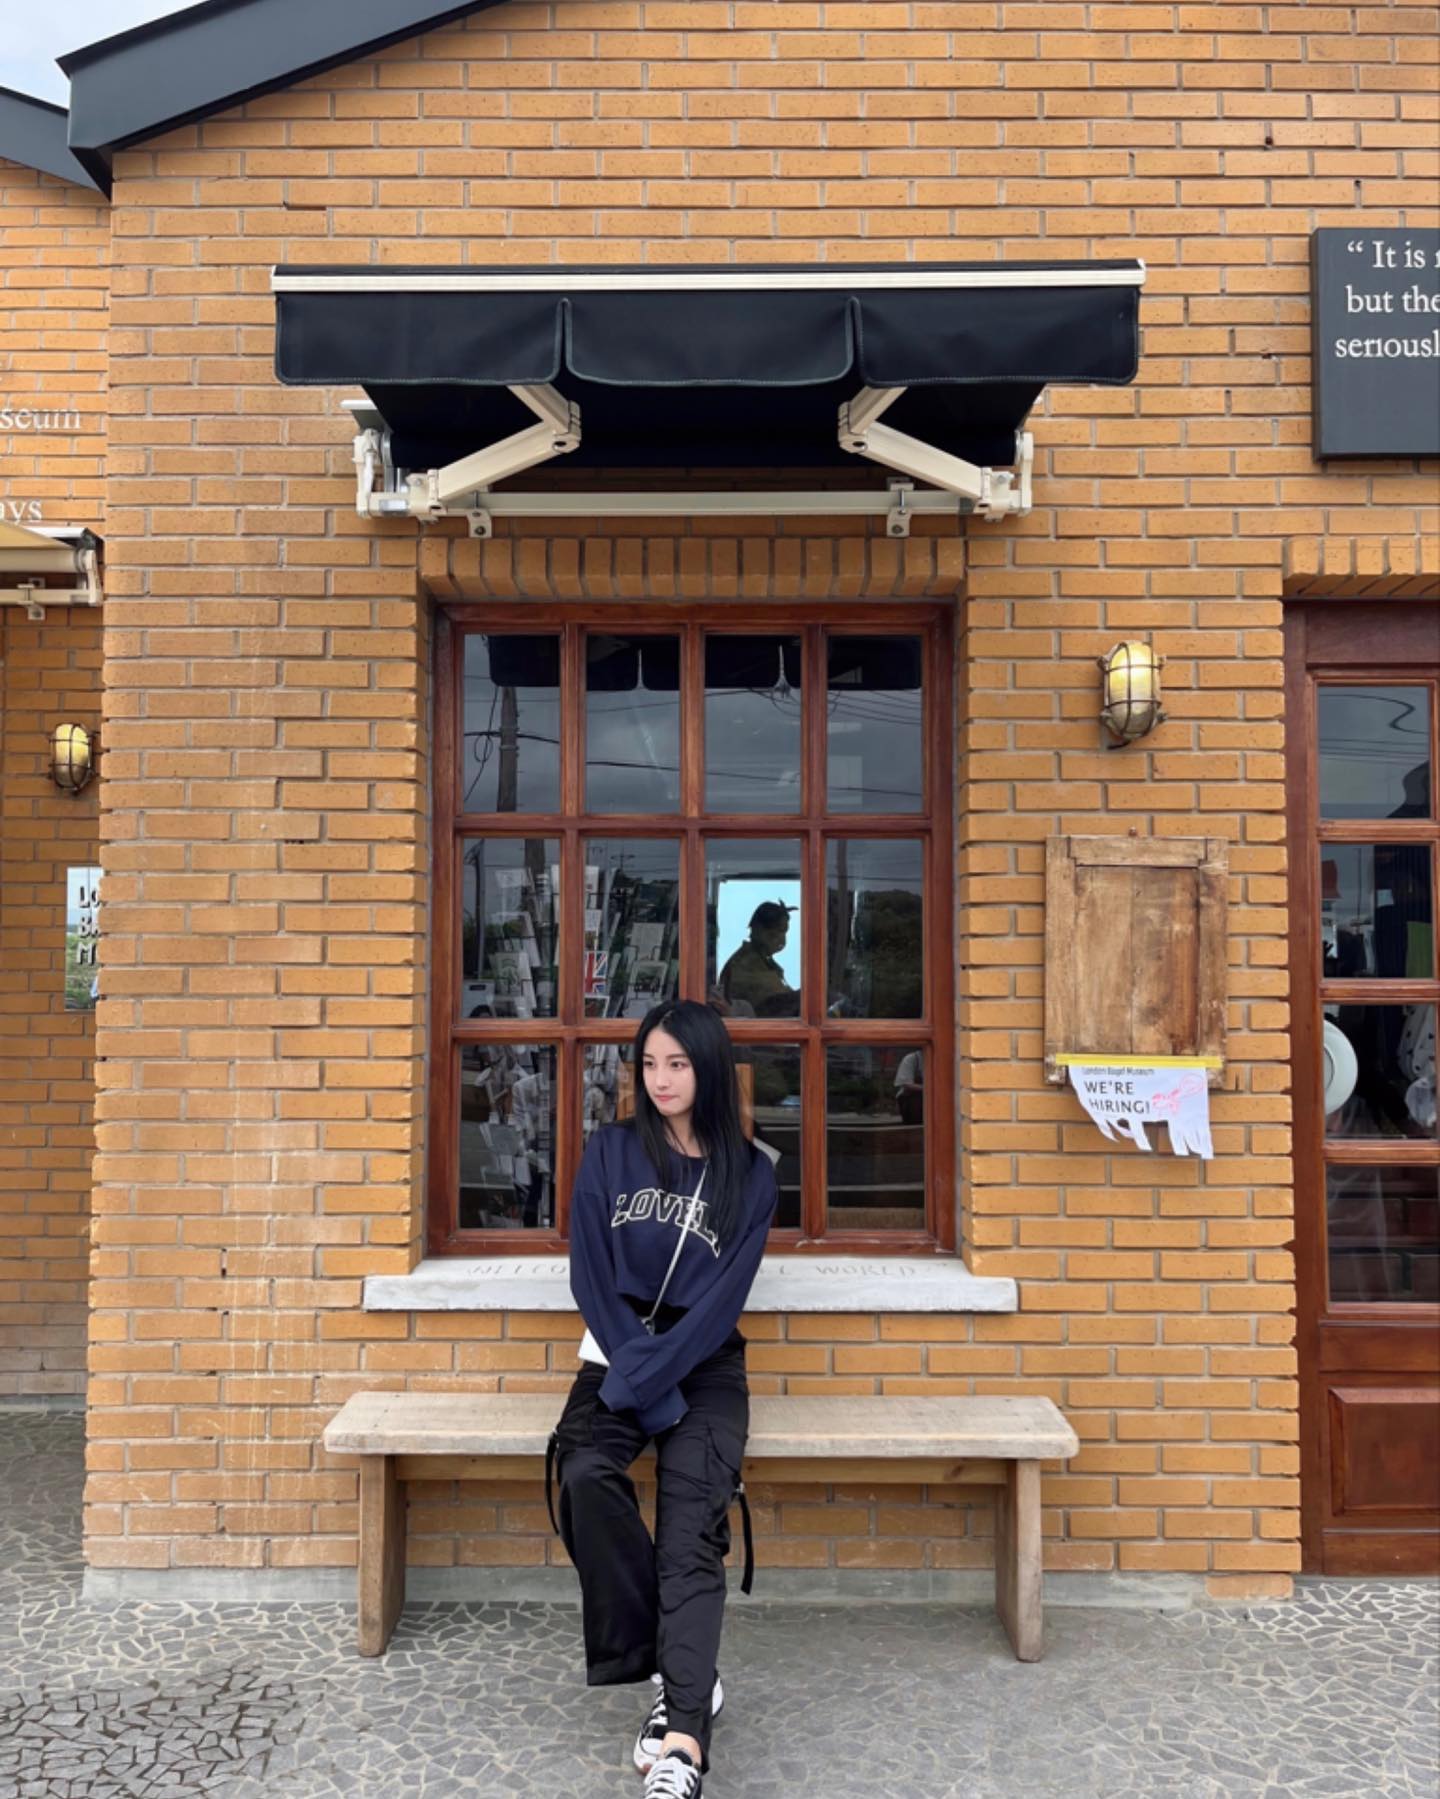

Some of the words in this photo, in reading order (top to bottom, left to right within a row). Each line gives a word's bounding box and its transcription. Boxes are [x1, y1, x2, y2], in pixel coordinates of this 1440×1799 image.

[1372, 241, 1396, 268] It
[1403, 240, 1426, 268] is
[1346, 285, 1394, 313] but
[1402, 285, 1440, 313] the
[1084, 1081, 1135, 1095] WE'RE
[1088, 1098, 1151, 1115] HIRING!
